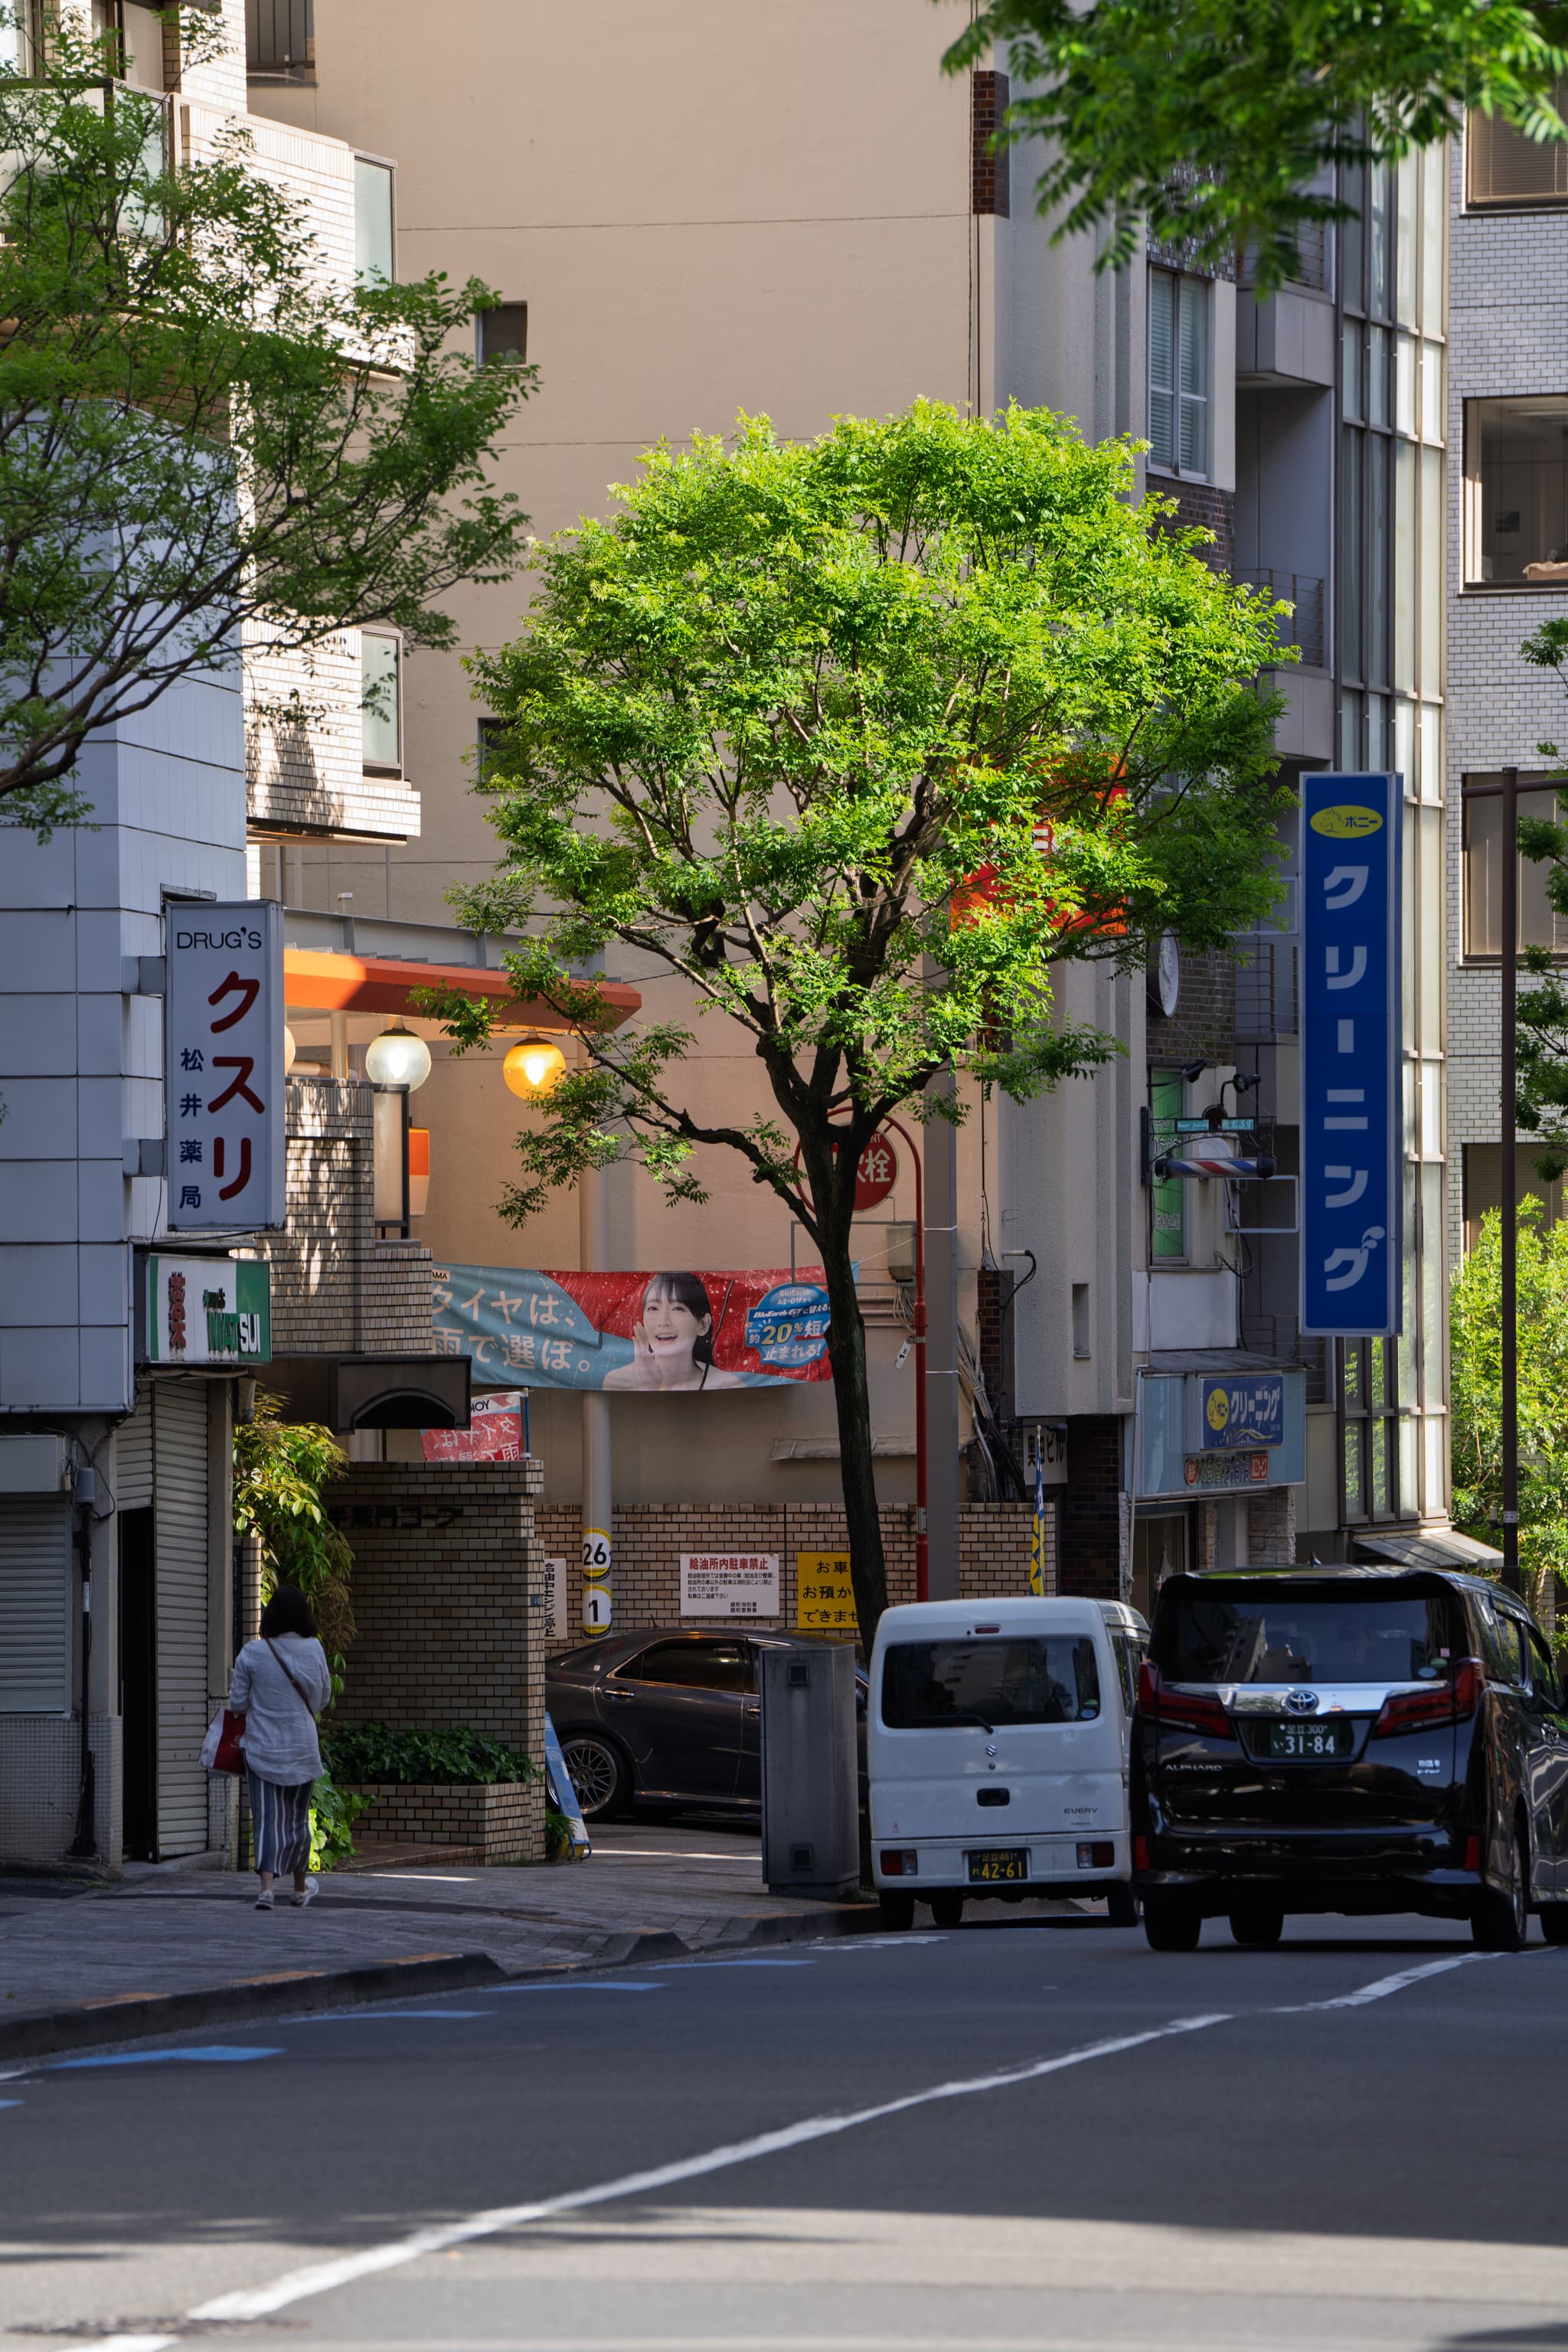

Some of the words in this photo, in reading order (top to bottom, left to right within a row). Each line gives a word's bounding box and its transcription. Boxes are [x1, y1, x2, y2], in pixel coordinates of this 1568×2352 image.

[1345, 815, 1378, 828] ポニー
[177, 926, 263, 950] DRUG'S
[207, 971, 265, 1201] クスリ
[1324, 865, 1385, 1292] クリーニング
[179, 1047, 204, 1209] 松井薬局
[432, 1284, 574, 1328] タイヤは、
[207, 1312, 261, 1354] MATSUI
[1230, 1386, 1280, 1424] クリーニング
[583, 1542, 607, 1566] 26
[689, 1557, 769, 1570] 給油所内駐車禁止
[589, 1599, 599, 1622] 1
[1306, 1724, 1324, 1734] 300
[1285, 1735, 1335, 1754] 31-84
[1165, 1763, 1223, 1772] ALPHARD
[1000, 1852, 1014, 1861] 481
[982, 1861, 1023, 1879] 42-61
